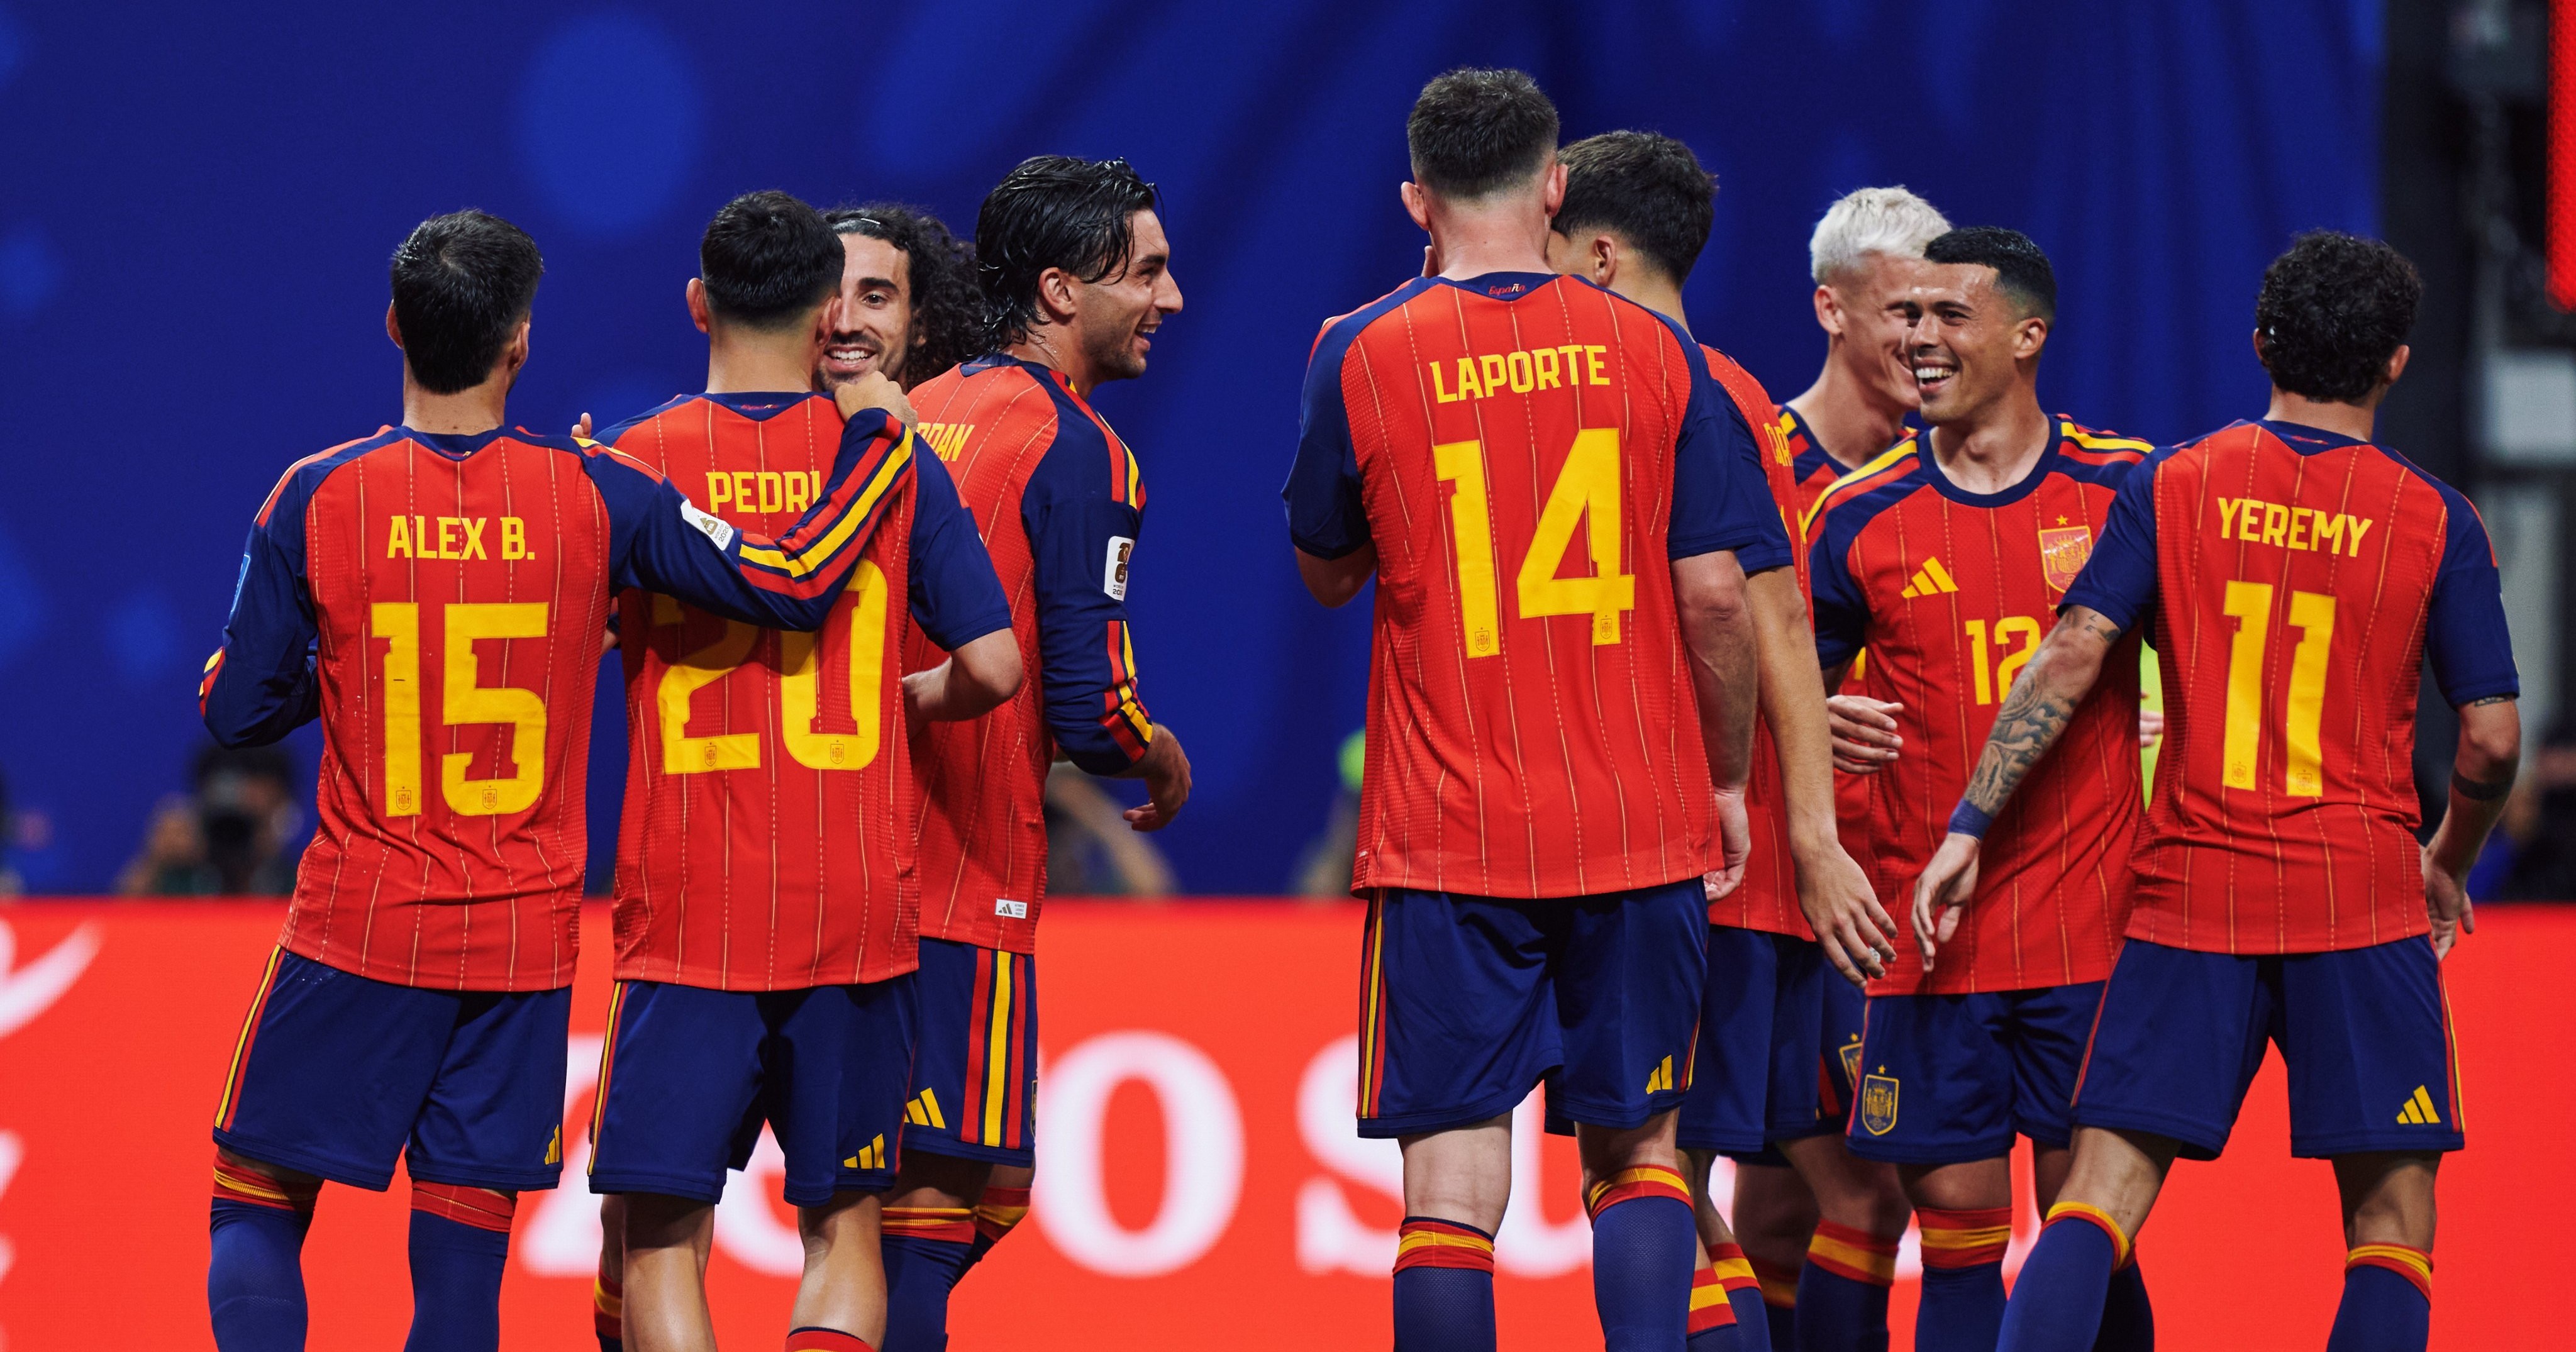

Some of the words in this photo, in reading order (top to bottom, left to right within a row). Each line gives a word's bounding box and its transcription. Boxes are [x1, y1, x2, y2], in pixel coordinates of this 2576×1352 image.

[1430, 344, 1611, 404] LAPORTE
[706, 470, 821, 514] PEDRI
[2218, 497, 2373, 557] YEREMY
[387, 515, 487, 560] ALEX
[500, 516, 535, 560] B.
[1433, 428, 1635, 659] 14
[657, 558, 888, 775] 20
[1965, 616, 2043, 706] 12
[2222, 580, 2336, 797] 11
[371, 602, 548, 817] 15
